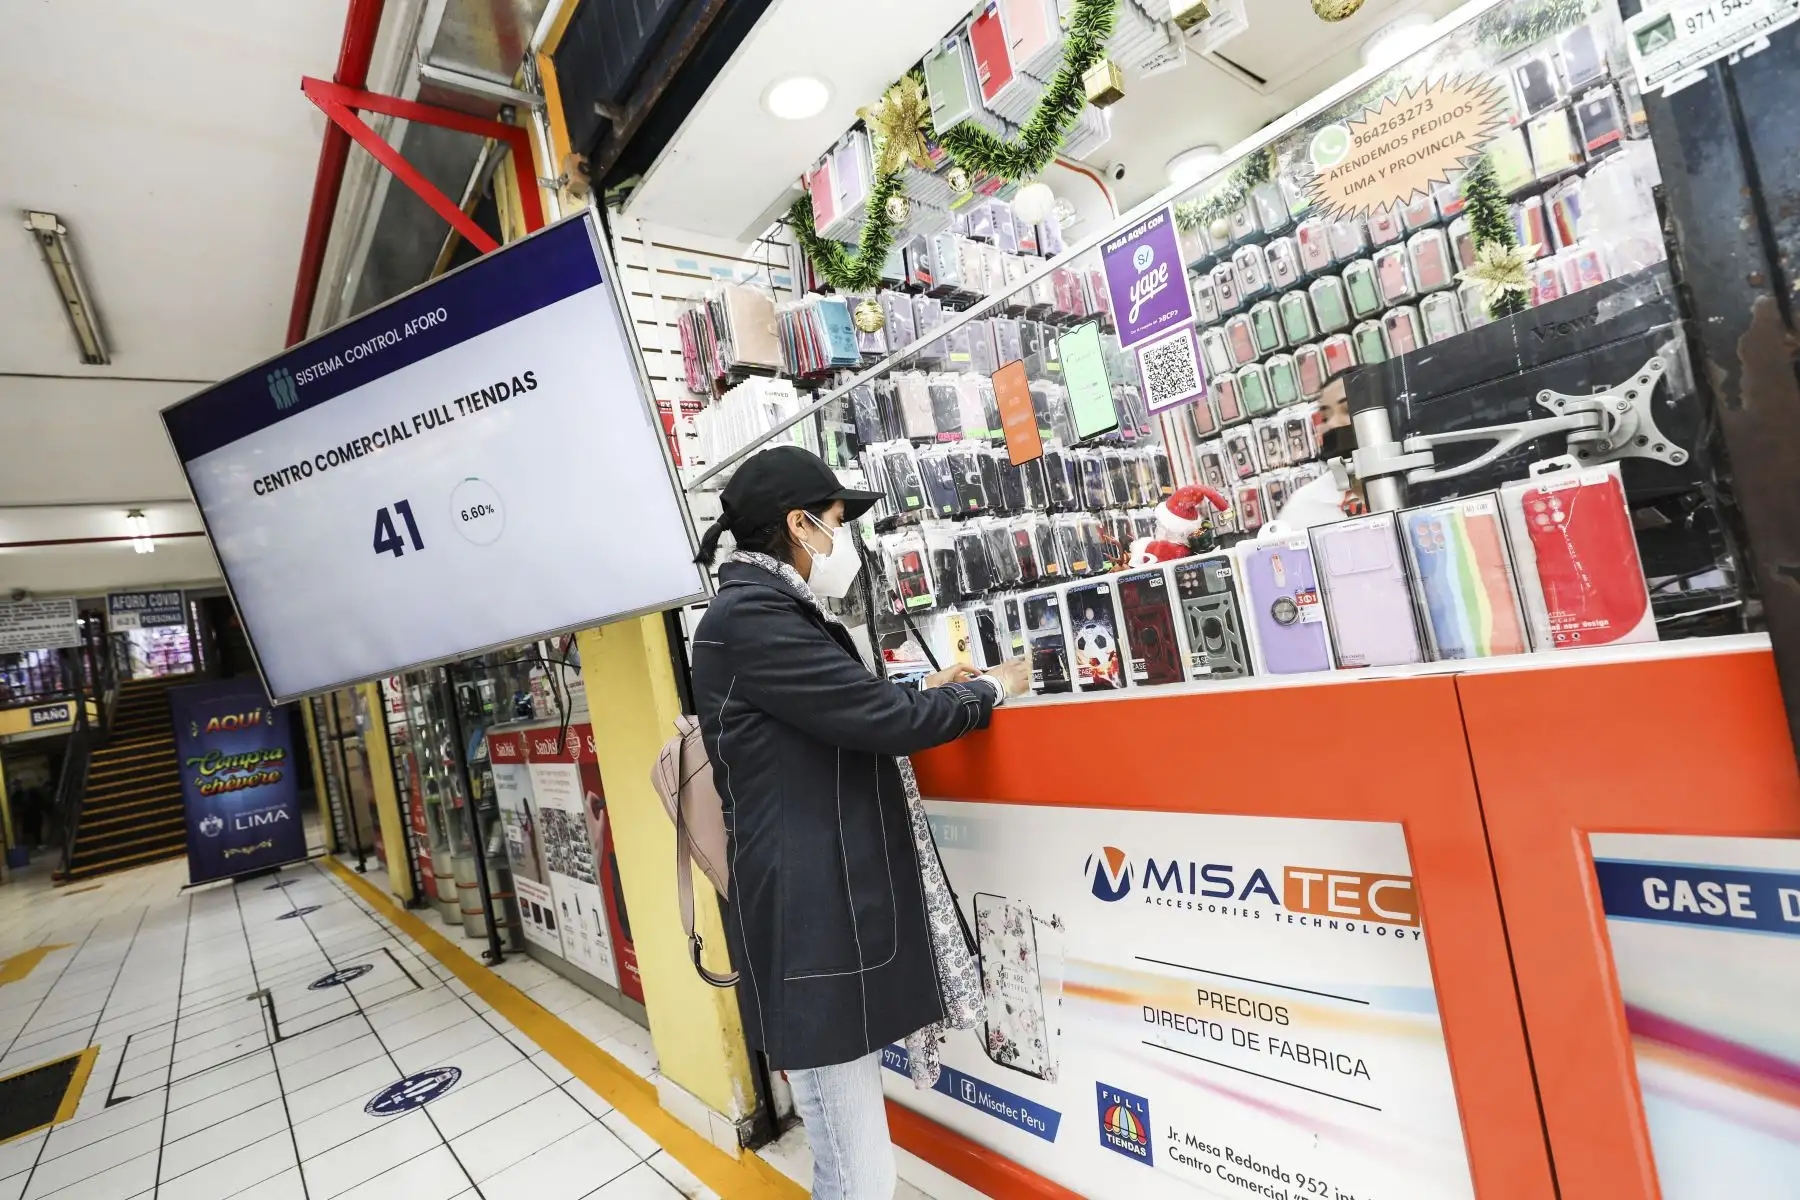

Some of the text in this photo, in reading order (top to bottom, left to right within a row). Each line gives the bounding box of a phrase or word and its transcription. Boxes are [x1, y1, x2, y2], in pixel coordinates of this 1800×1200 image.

[1685, 0, 1750, 34] 971 54
[1330, 101, 1473, 181] ATENDEMOS PEDIDOS
[1353, 98, 1434, 148] 964263273
[1344, 131, 1466, 196] LIMA Y PROVINCIA
[1107, 214, 1164, 253] PAGA AQUÍ CON
[1129, 262, 1168, 324] yape
[295, 307, 448, 386] SISTEMA CONTROL AFORO
[253, 370, 538, 496] CENTRO COMERCIAL FULL TIENDAS
[372, 499, 495, 557] 41 6.60%
[112, 592, 180, 609] AFORO COVID
[33, 708, 67, 722] BAÑO
[186, 748, 286, 776] Compra
[496, 742, 516, 757] SanDisk
[535, 738, 558, 755] SanDis
[235, 809, 290, 830] LIMA
[1142, 857, 1413, 921] MISATEC
[1642, 877, 1757, 920] CASE
[1145, 896, 1421, 941] ACCESSORIES TECHNOLOGY
[1198, 989, 1289, 1026] PRECIOS
[884, 1049, 902, 1068] 972
[1143, 1006, 1371, 1081] DIRECTO DE FABRICA
[978, 1091, 1046, 1132] Misatec Peru
[1102, 1090, 1144, 1113] FULL
[1105, 1132, 1148, 1157] TIENDAS
[1167, 1126, 1181, 1143] Jr.
[1185, 1133, 1221, 1158] Mesa
[1225, 1146, 1290, 1184] Redonda
[1295, 1173, 1329, 1199] 952
[1168, 1146, 1289, 1200] Centro Comercial
